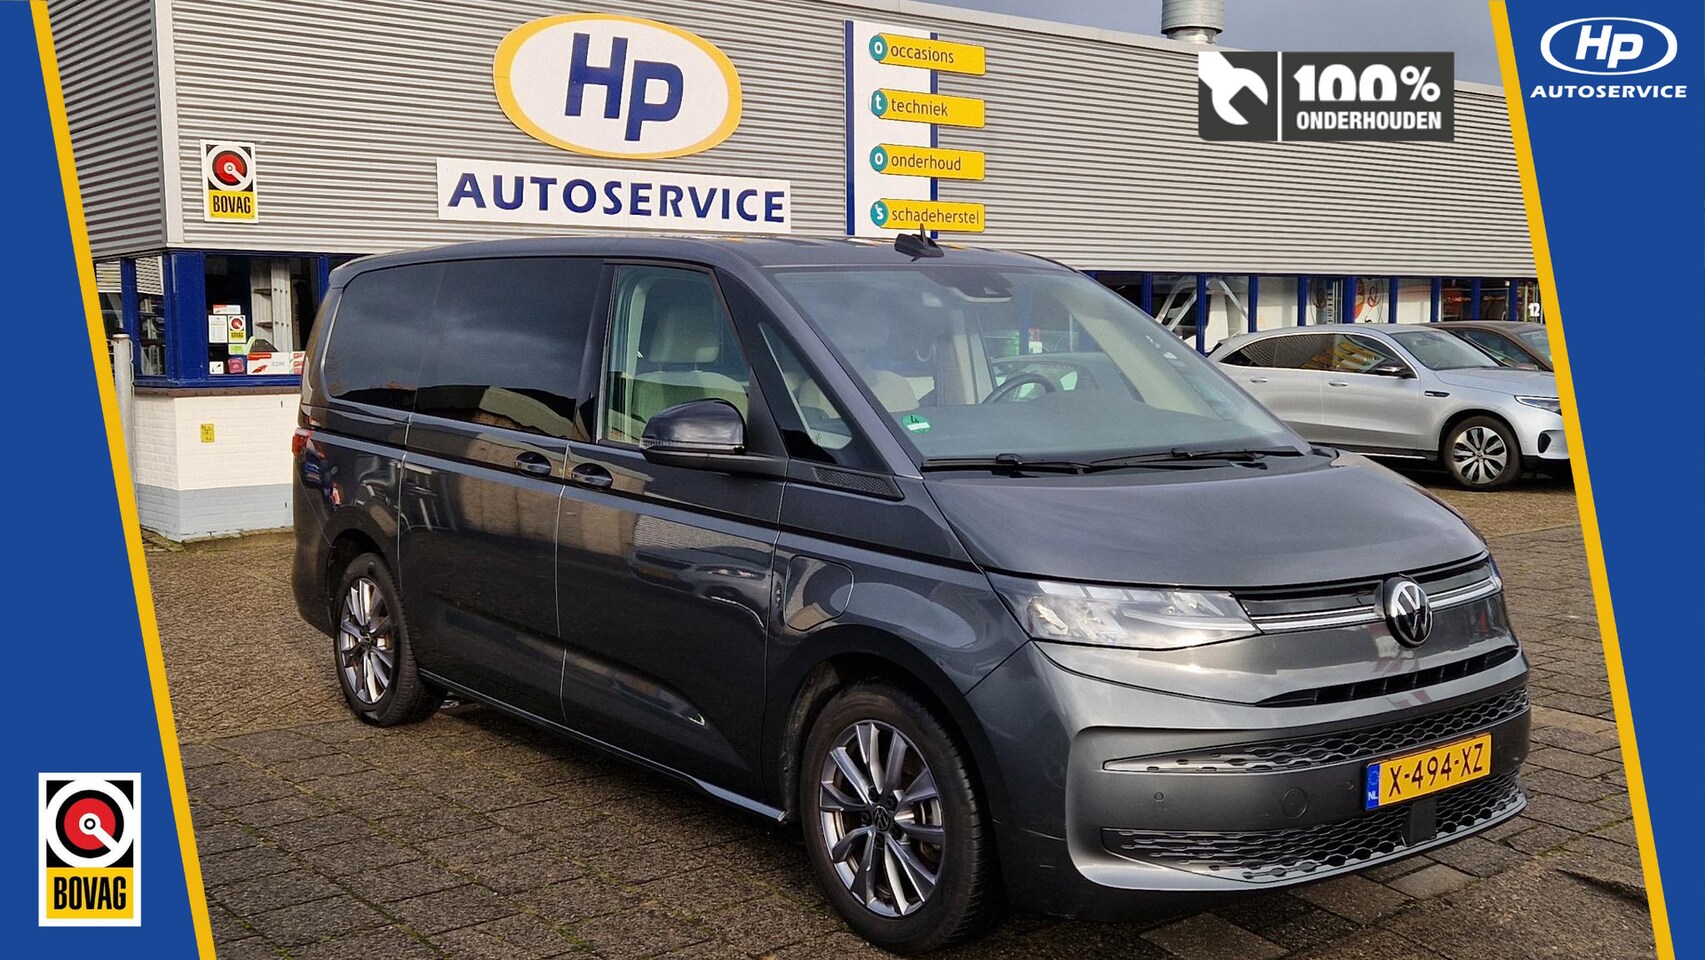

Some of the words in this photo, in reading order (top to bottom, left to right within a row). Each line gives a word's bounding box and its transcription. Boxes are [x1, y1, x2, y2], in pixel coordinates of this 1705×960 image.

[890, 45, 954, 64] occasions
[564, 32, 684, 141] Hp
[891, 98, 948, 117] techniek
[891, 153, 961, 171] onderhoud
[213, 195, 251, 214] BOVAG
[448, 172, 785, 223] AUTOSERVICE
[892, 206, 980, 224] schadeherstel
[1528, 302, 1540, 317] 12
[1368, 790, 1378, 800] NL
[1388, 742, 1484, 797] X-494-XZ
